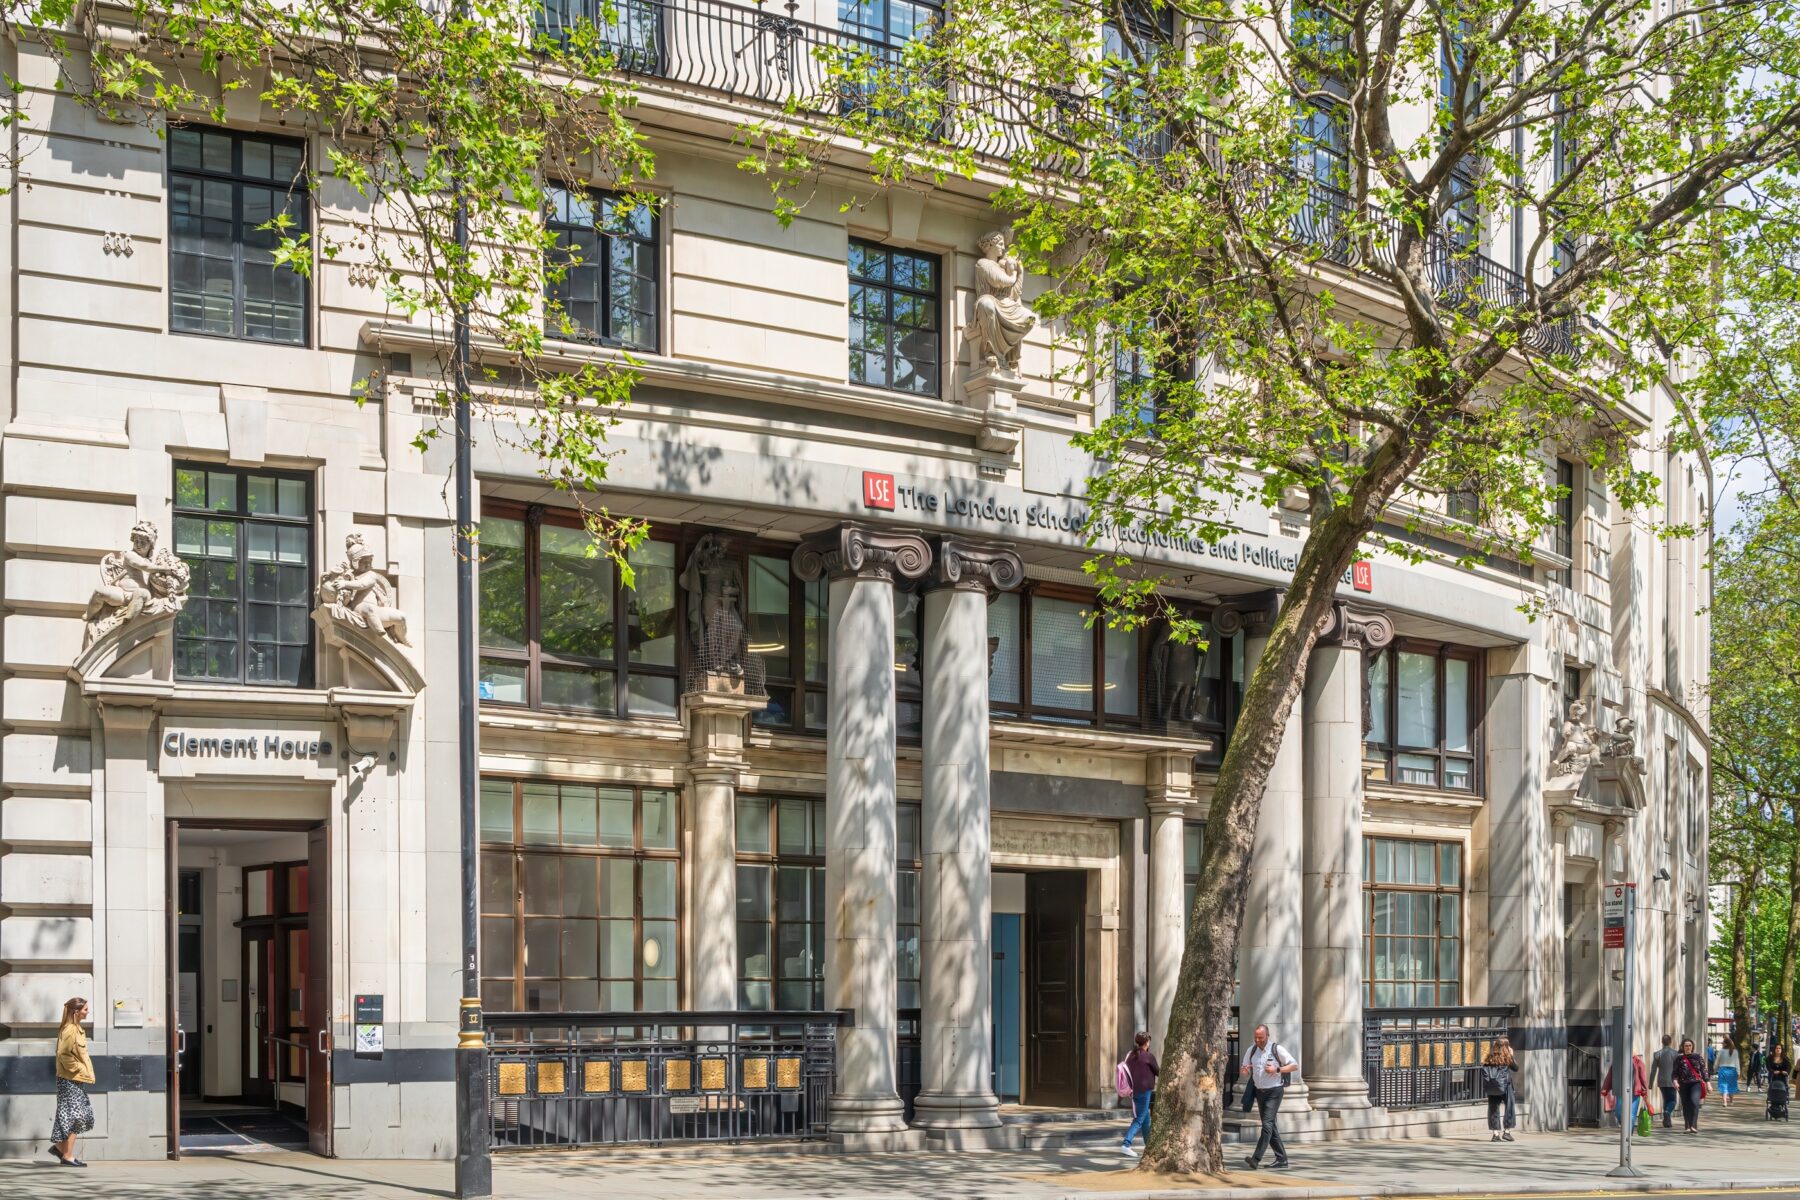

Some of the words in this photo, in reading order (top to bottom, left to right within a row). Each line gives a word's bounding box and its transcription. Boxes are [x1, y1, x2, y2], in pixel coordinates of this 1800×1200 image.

[869, 477, 890, 502] LSE
[898, 484, 938, 513] The
[945, 491, 1020, 525] London
[1026, 504, 1087, 533] School
[1093, 514, 1114, 539] of
[1209, 538, 1239, 562] and
[1242, 543, 1299, 573] Political
[1356, 565, 1370, 586] LSE
[164, 732, 259, 758] Clement
[264, 735, 333, 759] House
